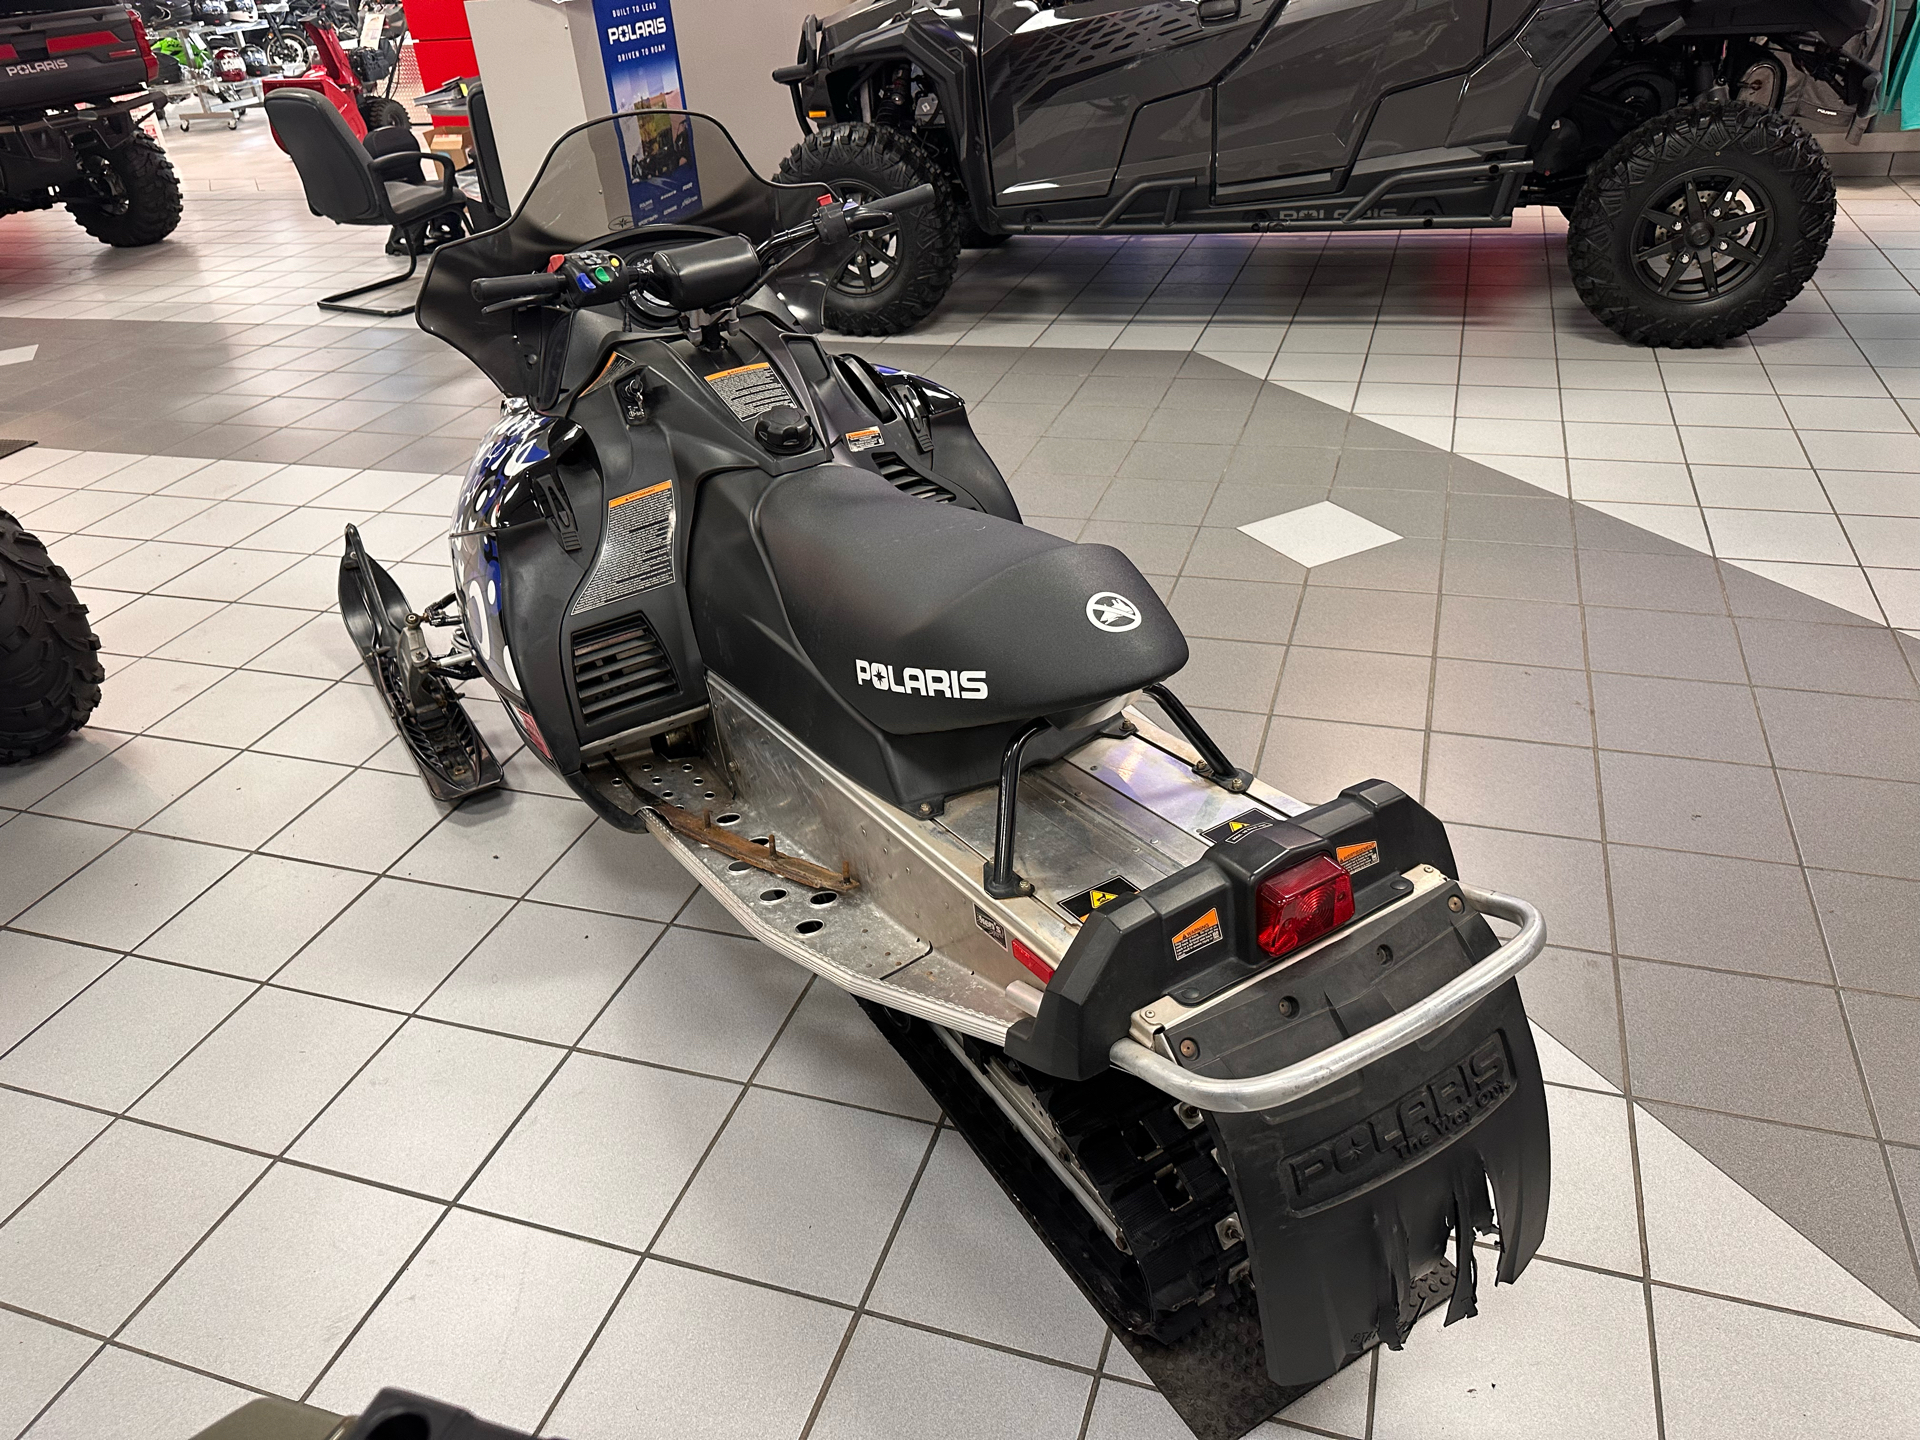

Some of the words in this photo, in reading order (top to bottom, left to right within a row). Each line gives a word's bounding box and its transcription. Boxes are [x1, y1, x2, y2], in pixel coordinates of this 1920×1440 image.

[612, 7, 630, 17] BUILT
[632, 5, 640, 14] TO
[641, 2, 657, 12] LEAD
[607, 17, 667, 45] POLARIS
[617, 50, 640, 62] DRIVEN
[641, 48, 649, 56] TO
[650, 44, 666, 53] ROAM
[5, 59, 68, 77] POLARIS
[855, 658, 989, 700] POLARIS
[1187, 923, 1210, 937] WARNING
[1289, 1038, 1504, 1196] POLARIS
[1393, 1131, 1430, 1159] The
[1431, 1103, 1474, 1135] Way
[1475, 1079, 1511, 1108] Out
